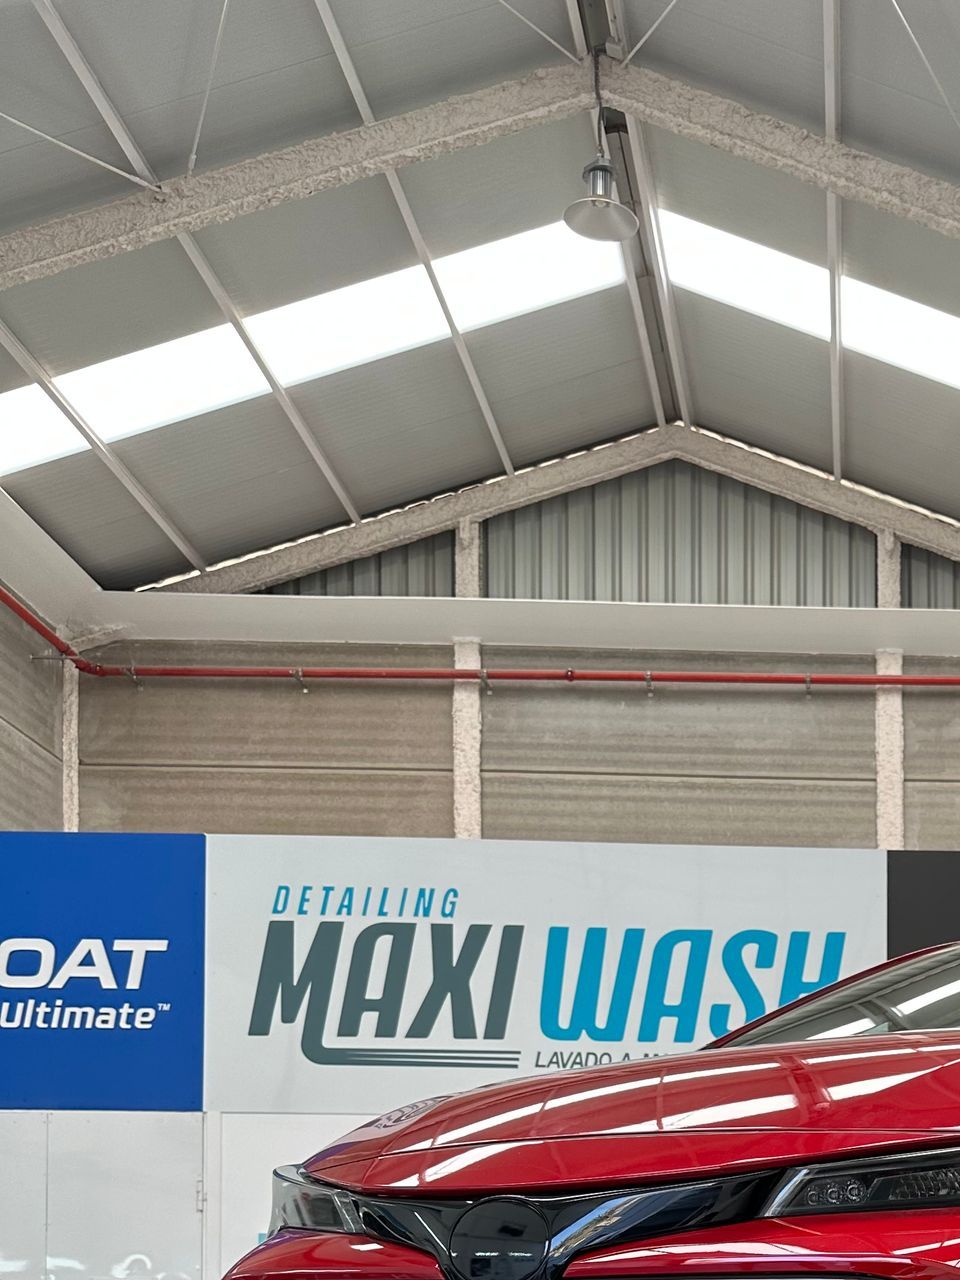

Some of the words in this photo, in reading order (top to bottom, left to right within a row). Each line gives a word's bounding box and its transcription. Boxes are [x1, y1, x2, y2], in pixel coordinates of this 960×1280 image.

[270, 885, 459, 918] DETAILING
[247, 920, 525, 1041] MAXI
[540, 926, 846, 1042] WASH
[535, 1051, 612, 1068] LAVADO
